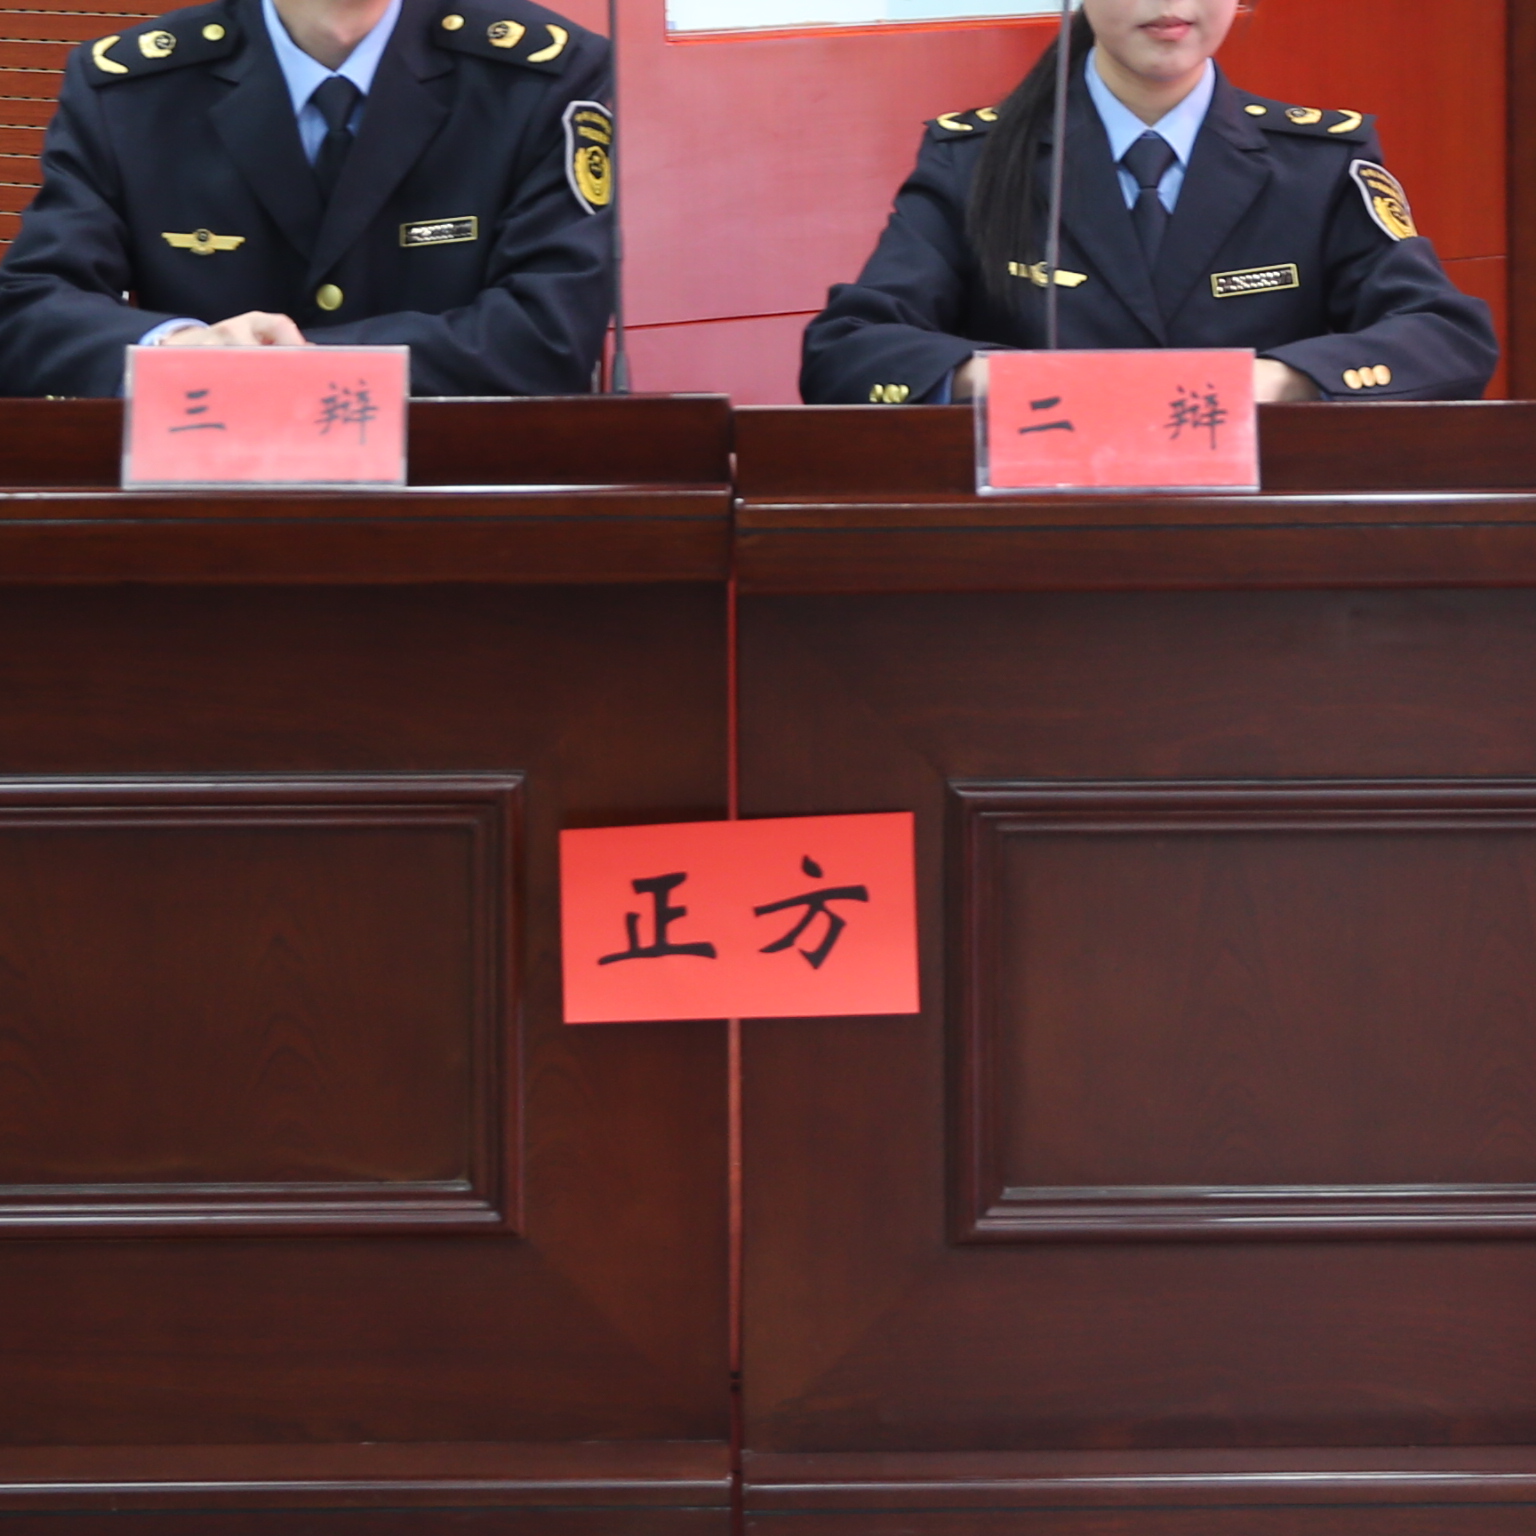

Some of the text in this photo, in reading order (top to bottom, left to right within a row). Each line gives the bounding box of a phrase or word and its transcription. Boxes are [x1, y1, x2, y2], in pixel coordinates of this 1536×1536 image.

[168, 378, 380, 446] 三辩
[1018, 381, 1229, 451] 二辩
[596, 854, 870, 970] 正方
